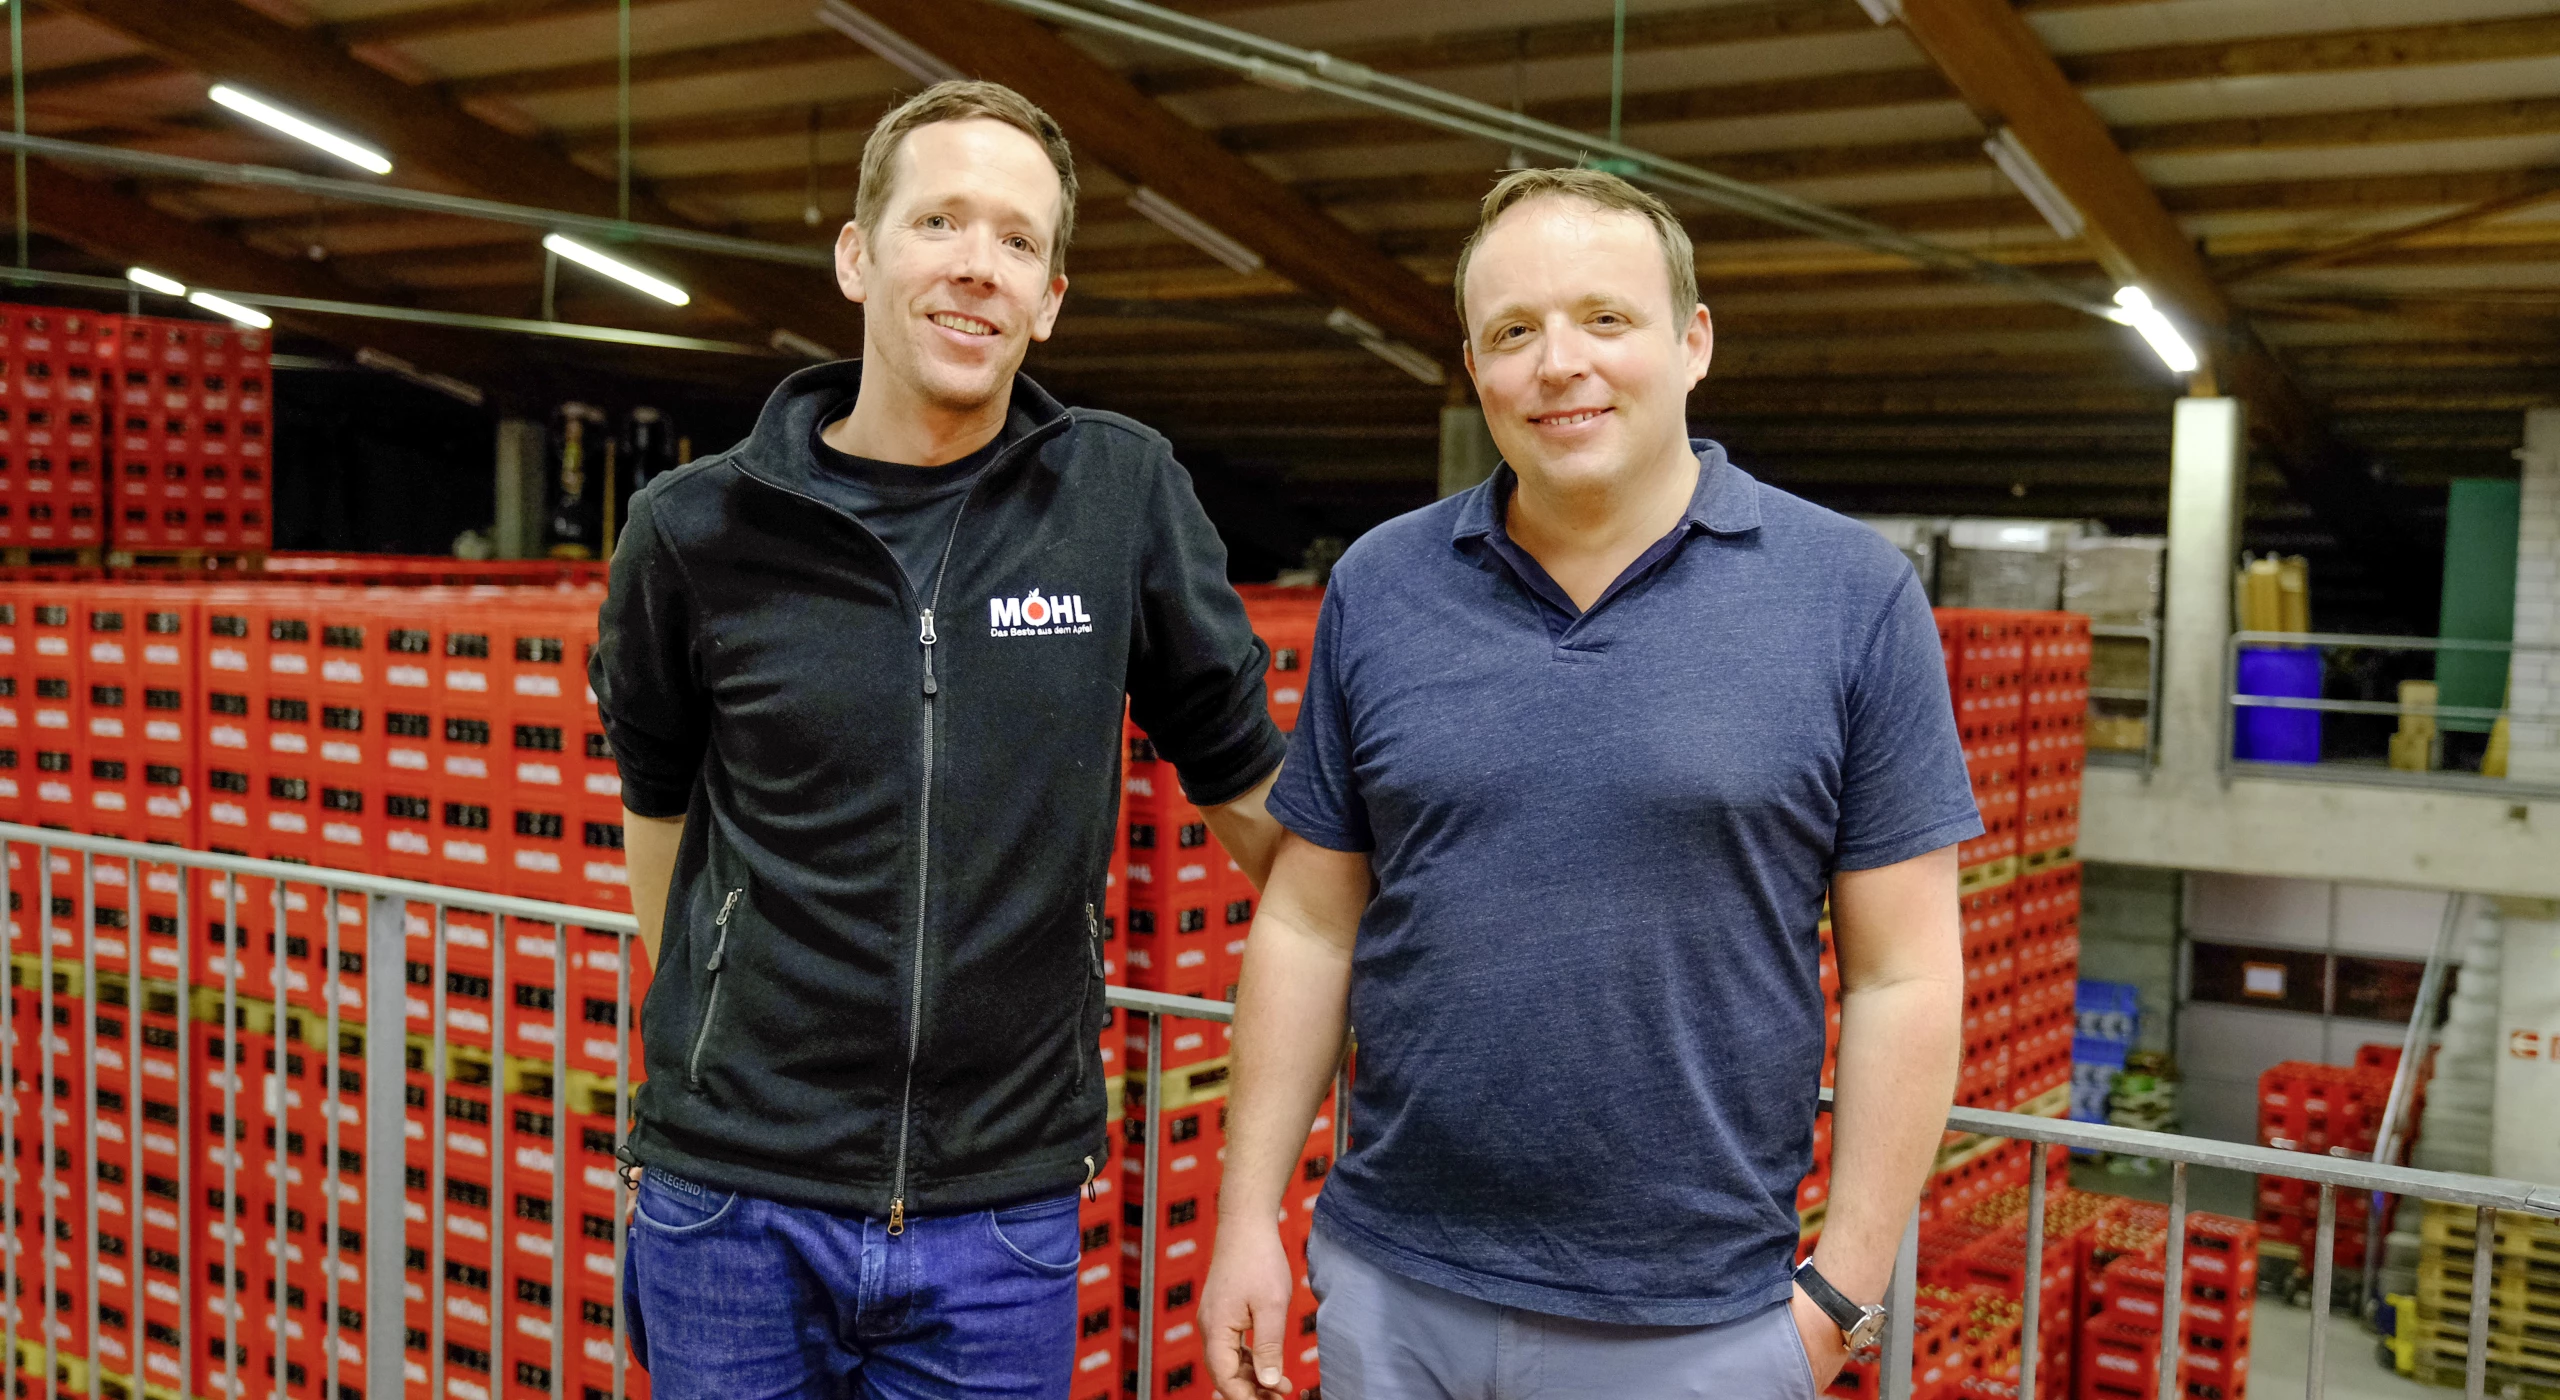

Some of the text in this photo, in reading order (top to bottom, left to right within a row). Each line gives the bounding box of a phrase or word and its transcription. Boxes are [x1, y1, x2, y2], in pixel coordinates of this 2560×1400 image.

[990, 624, 1093, 637] Das Beste aus dem Apfel
[663, 1172, 701, 1196] LEGEND
